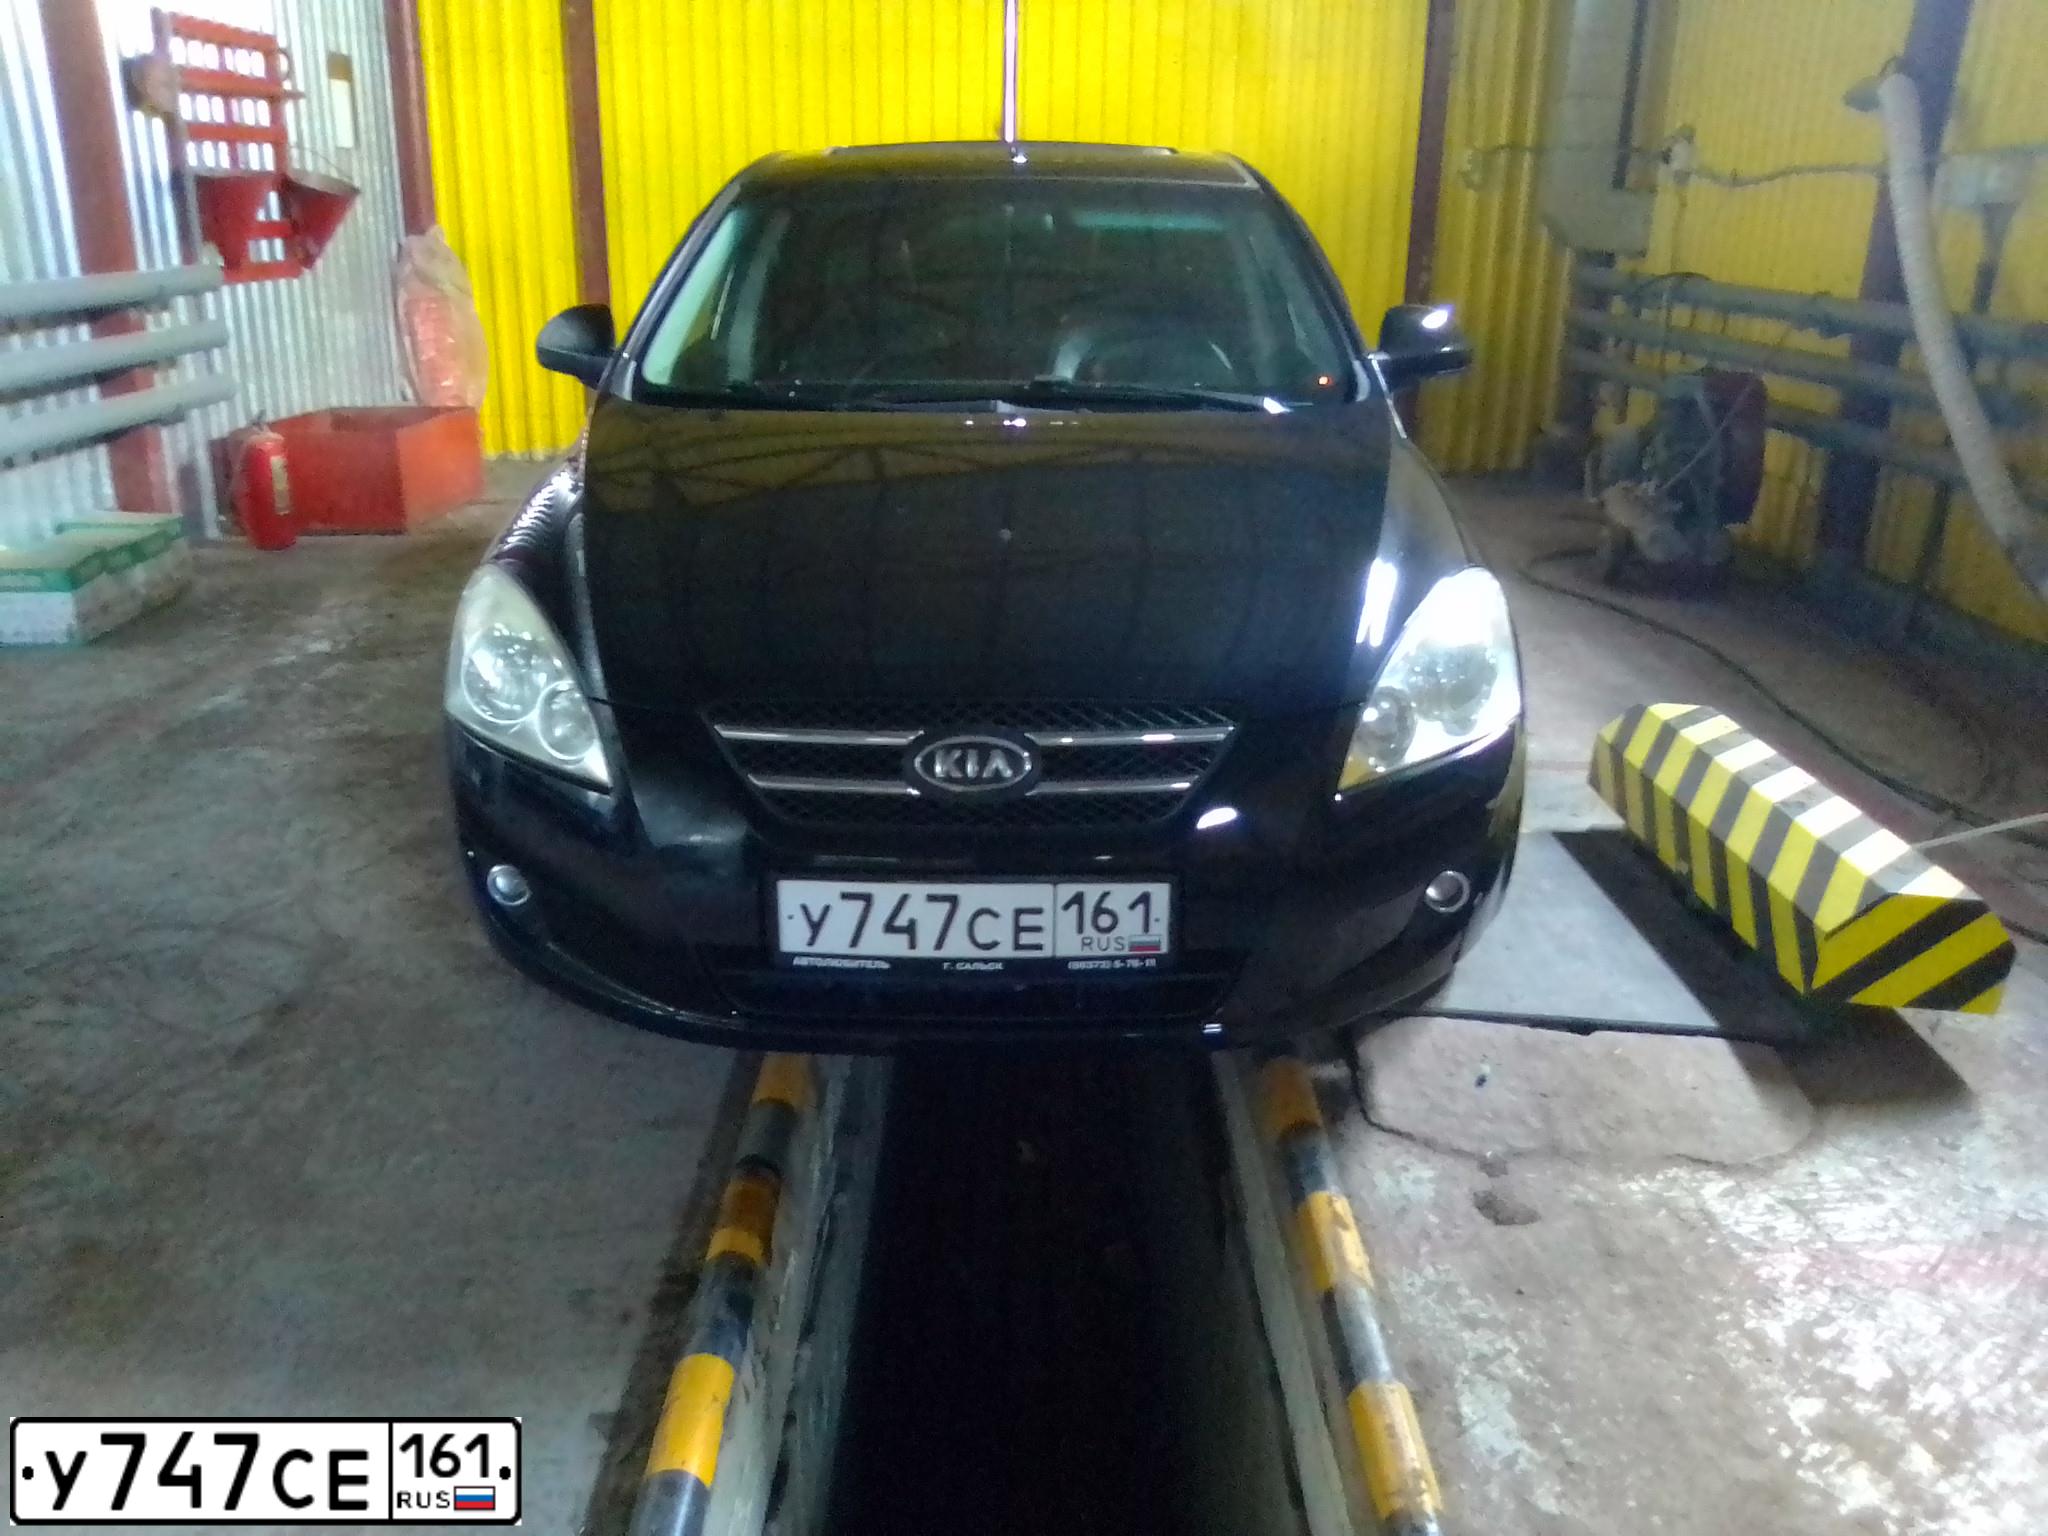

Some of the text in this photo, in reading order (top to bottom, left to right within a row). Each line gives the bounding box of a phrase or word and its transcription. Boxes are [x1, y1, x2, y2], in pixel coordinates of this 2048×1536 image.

[934, 748, 1013, 778] KIA
[1061, 891, 1152, 935] 161
[1080, 936, 1126, 952] RUS
